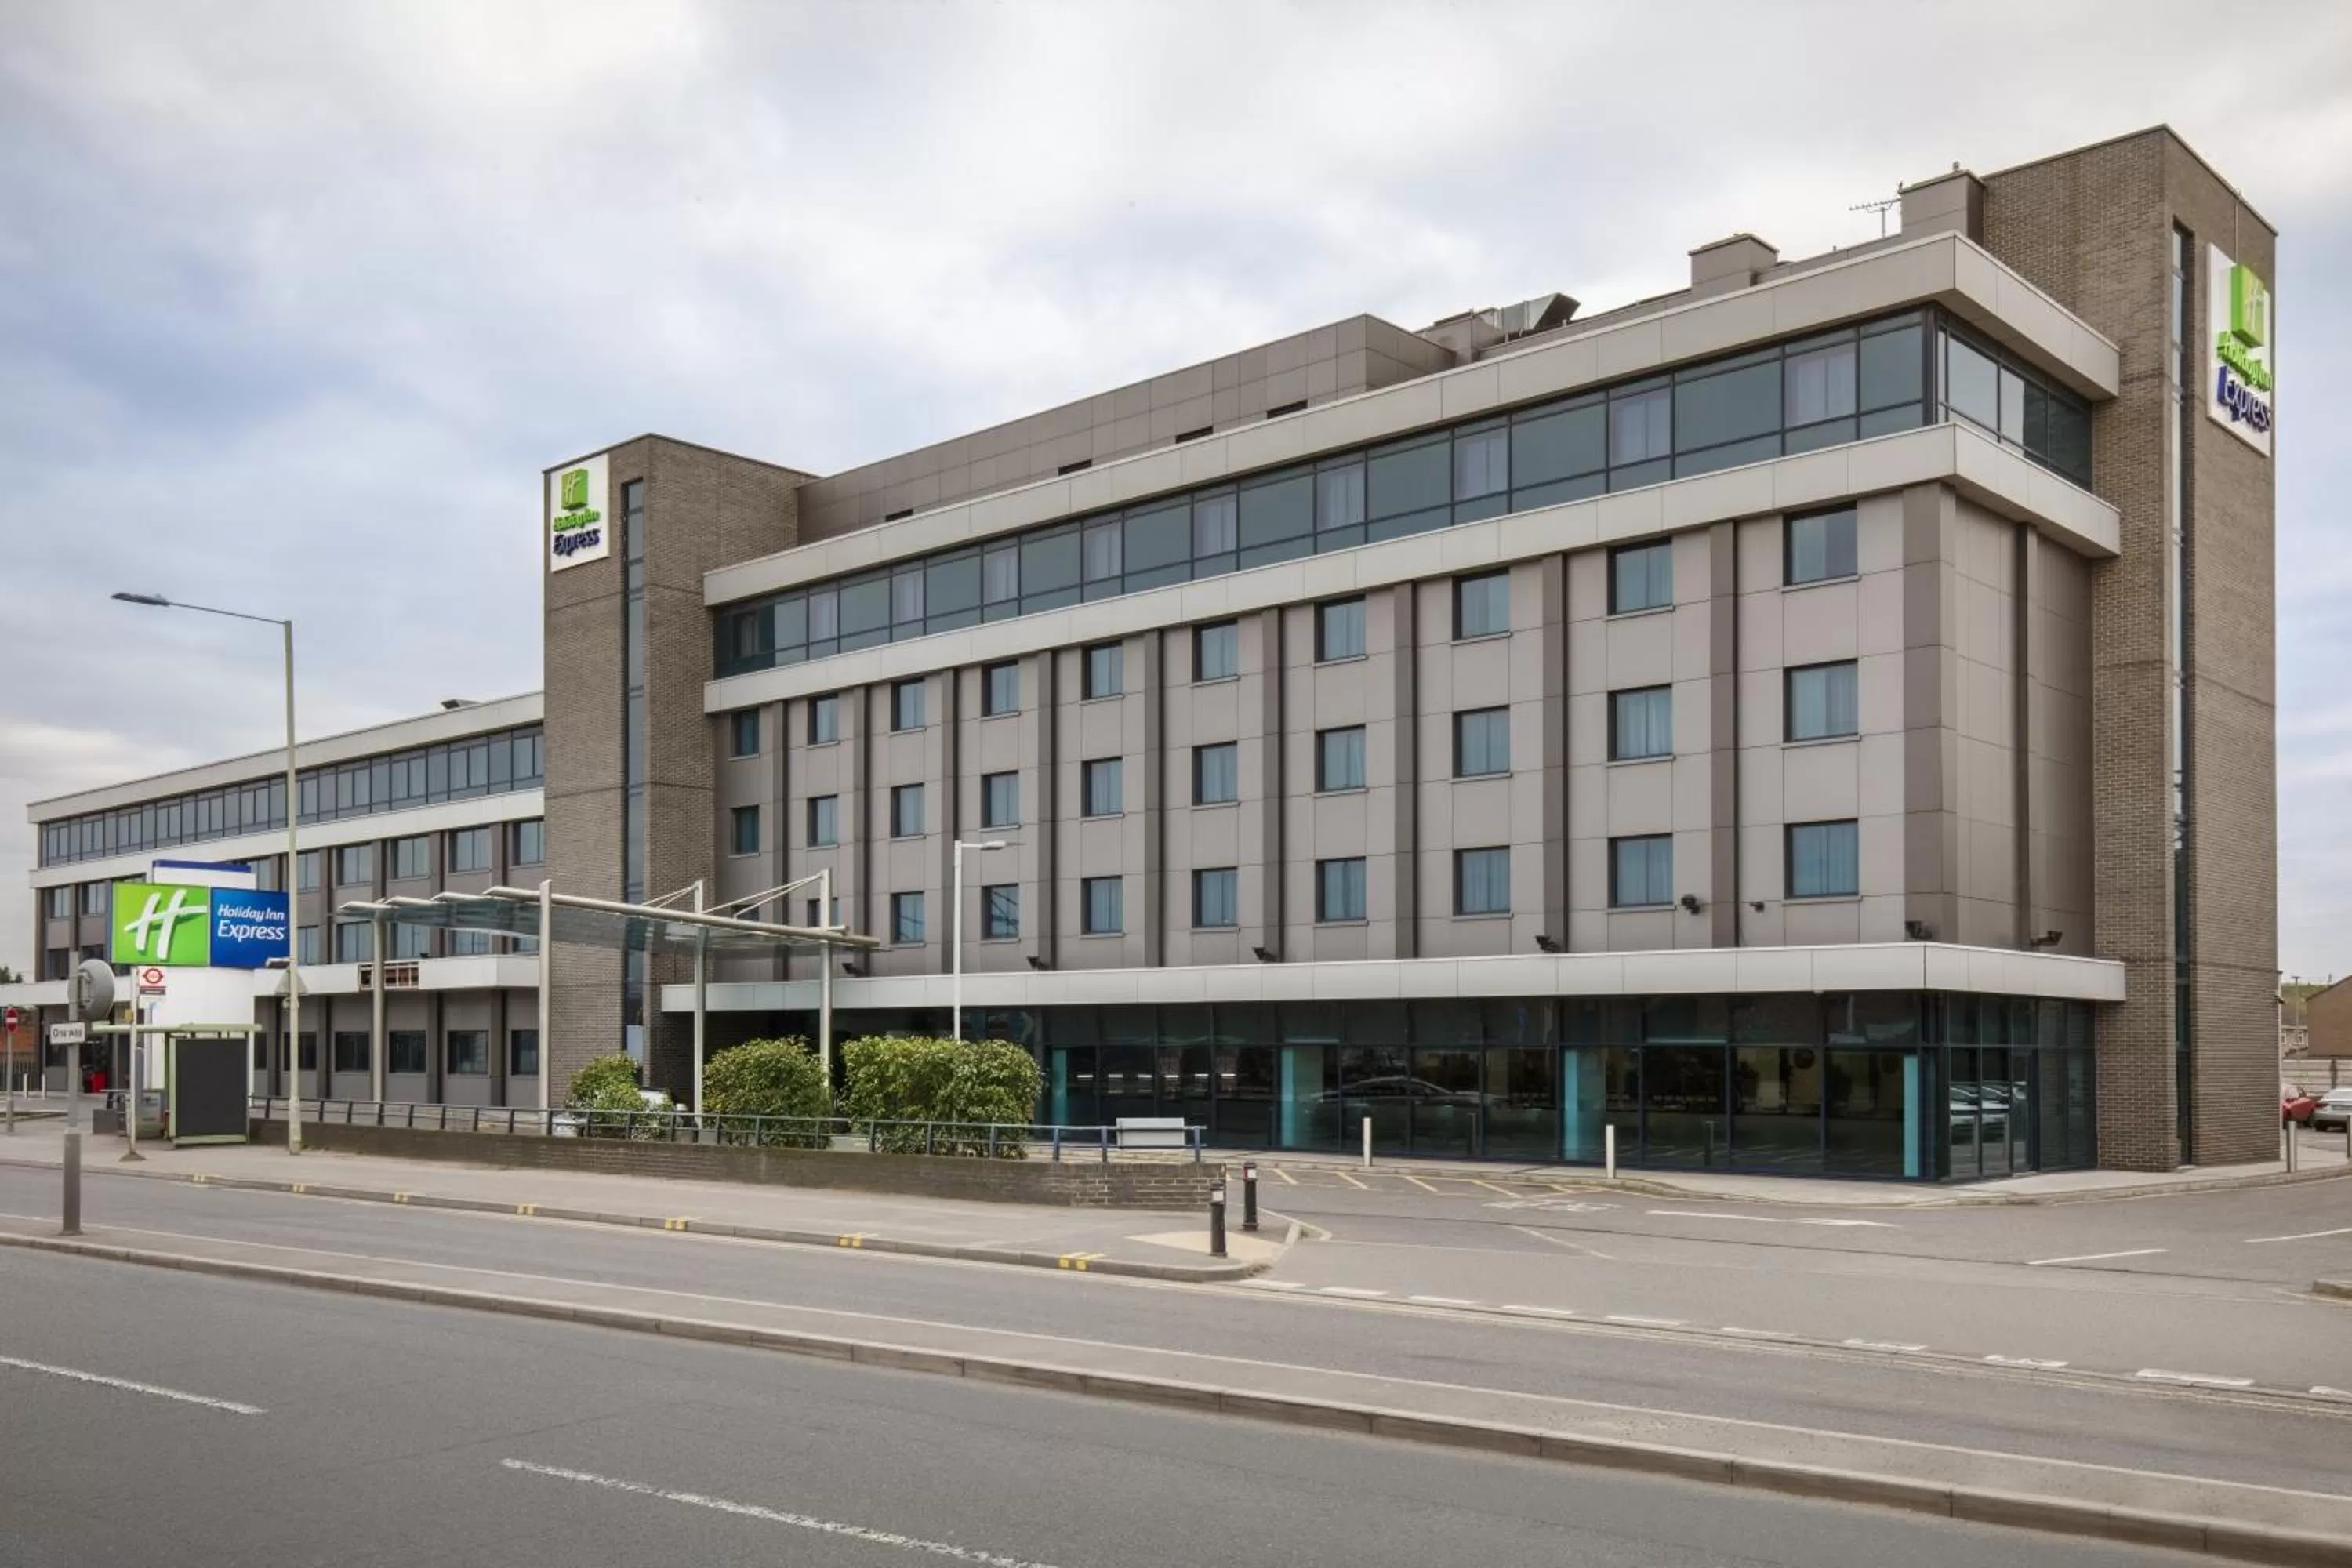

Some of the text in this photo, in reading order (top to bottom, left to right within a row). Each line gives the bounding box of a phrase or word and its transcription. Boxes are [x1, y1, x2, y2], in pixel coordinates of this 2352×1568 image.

[2218, 366, 2271, 431] Expres
[217, 903, 285, 922] Holiday Inn
[217, 920, 285, 942] Express
